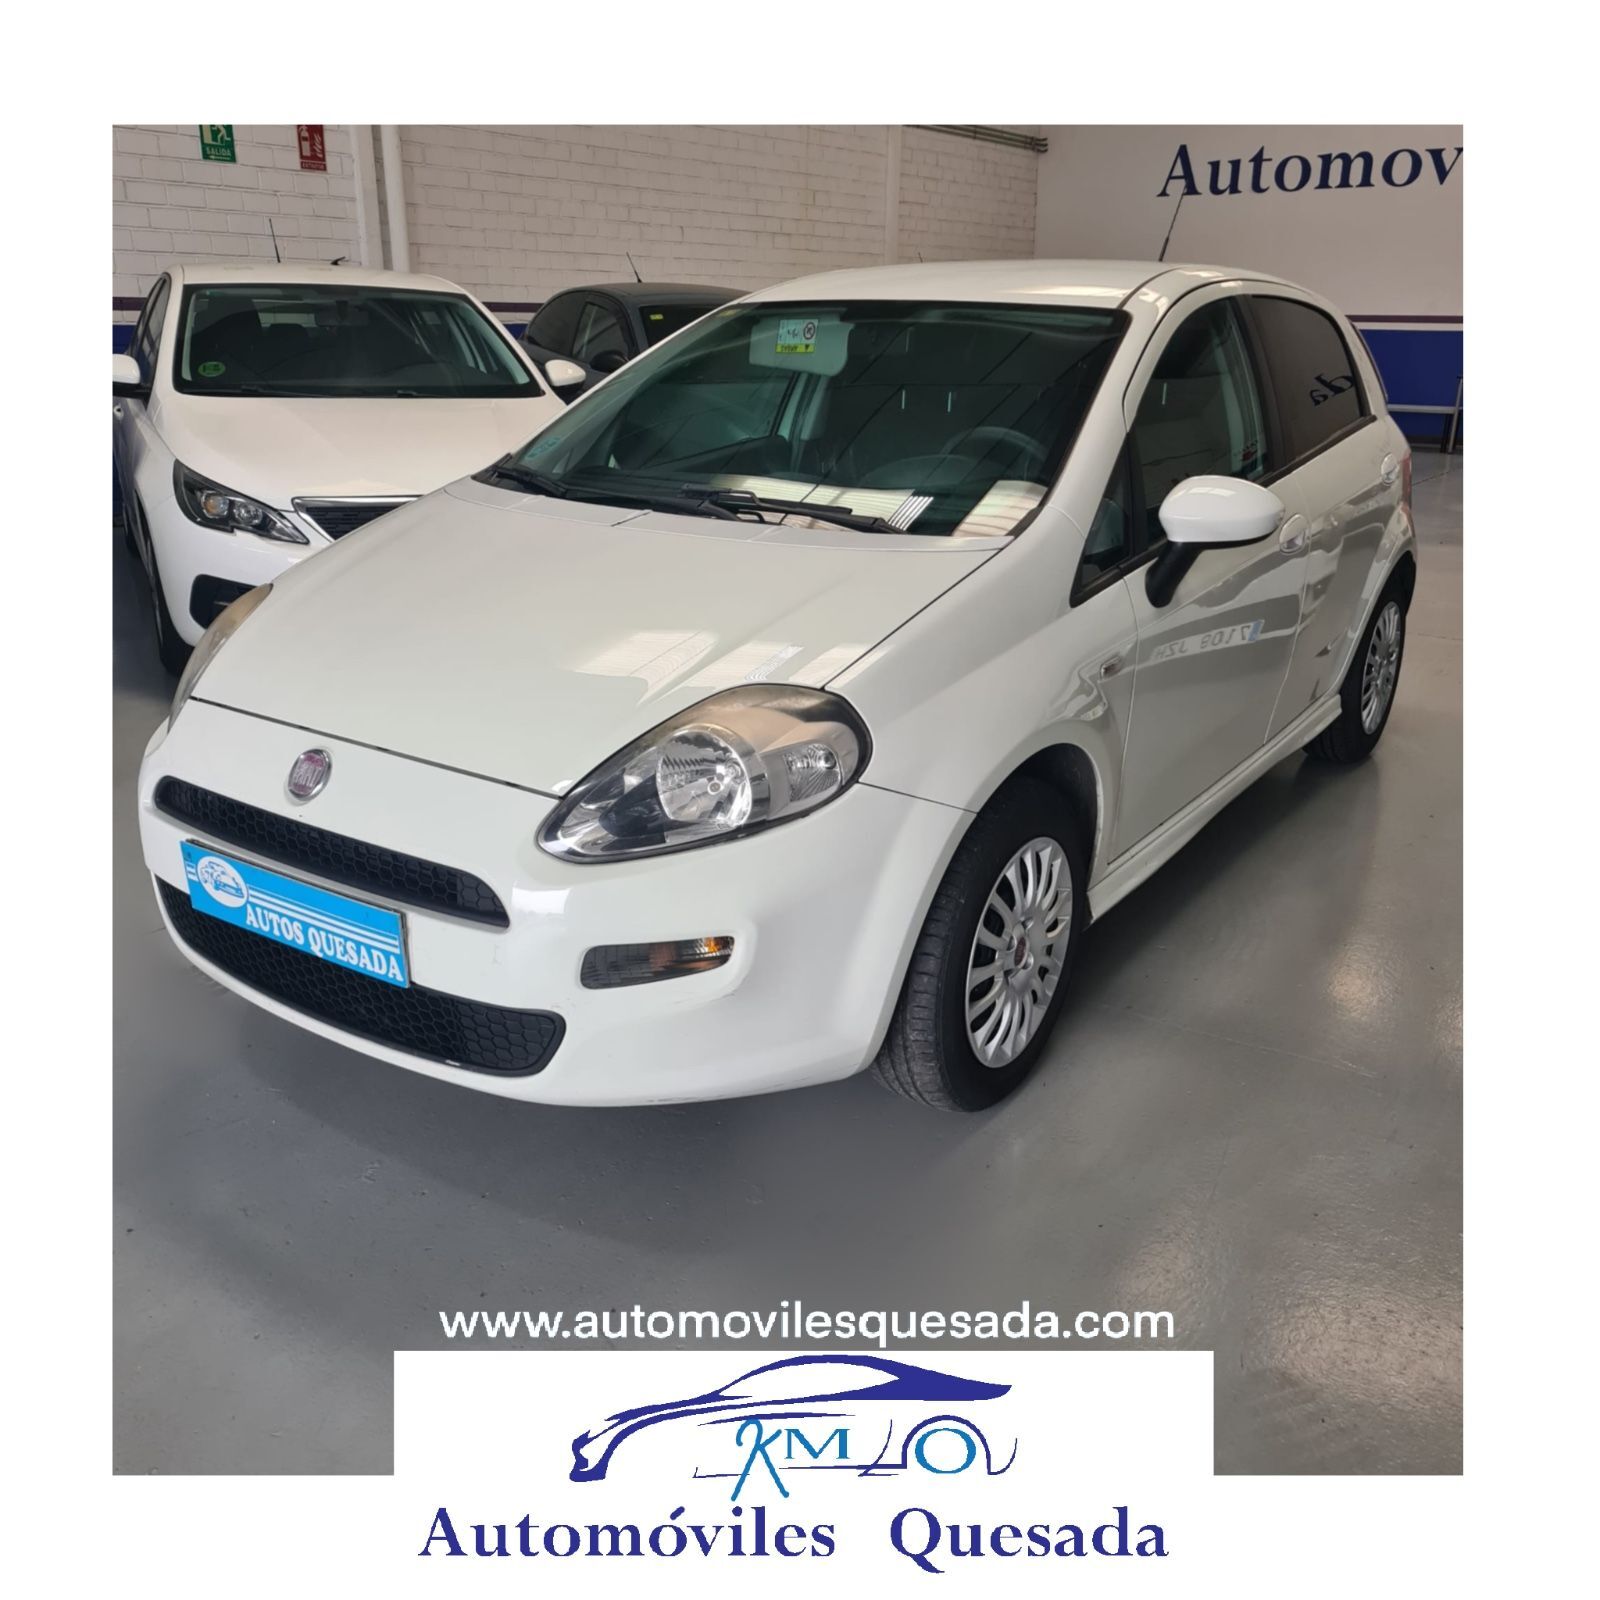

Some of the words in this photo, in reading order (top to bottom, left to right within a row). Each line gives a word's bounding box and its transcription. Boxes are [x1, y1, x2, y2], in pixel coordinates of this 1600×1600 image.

[206, 147, 232, 156] SALIDA
[1156, 144, 1463, 197] Automov
[246, 903, 305, 945] AUTOS
[307, 927, 404, 982] QUESADA
